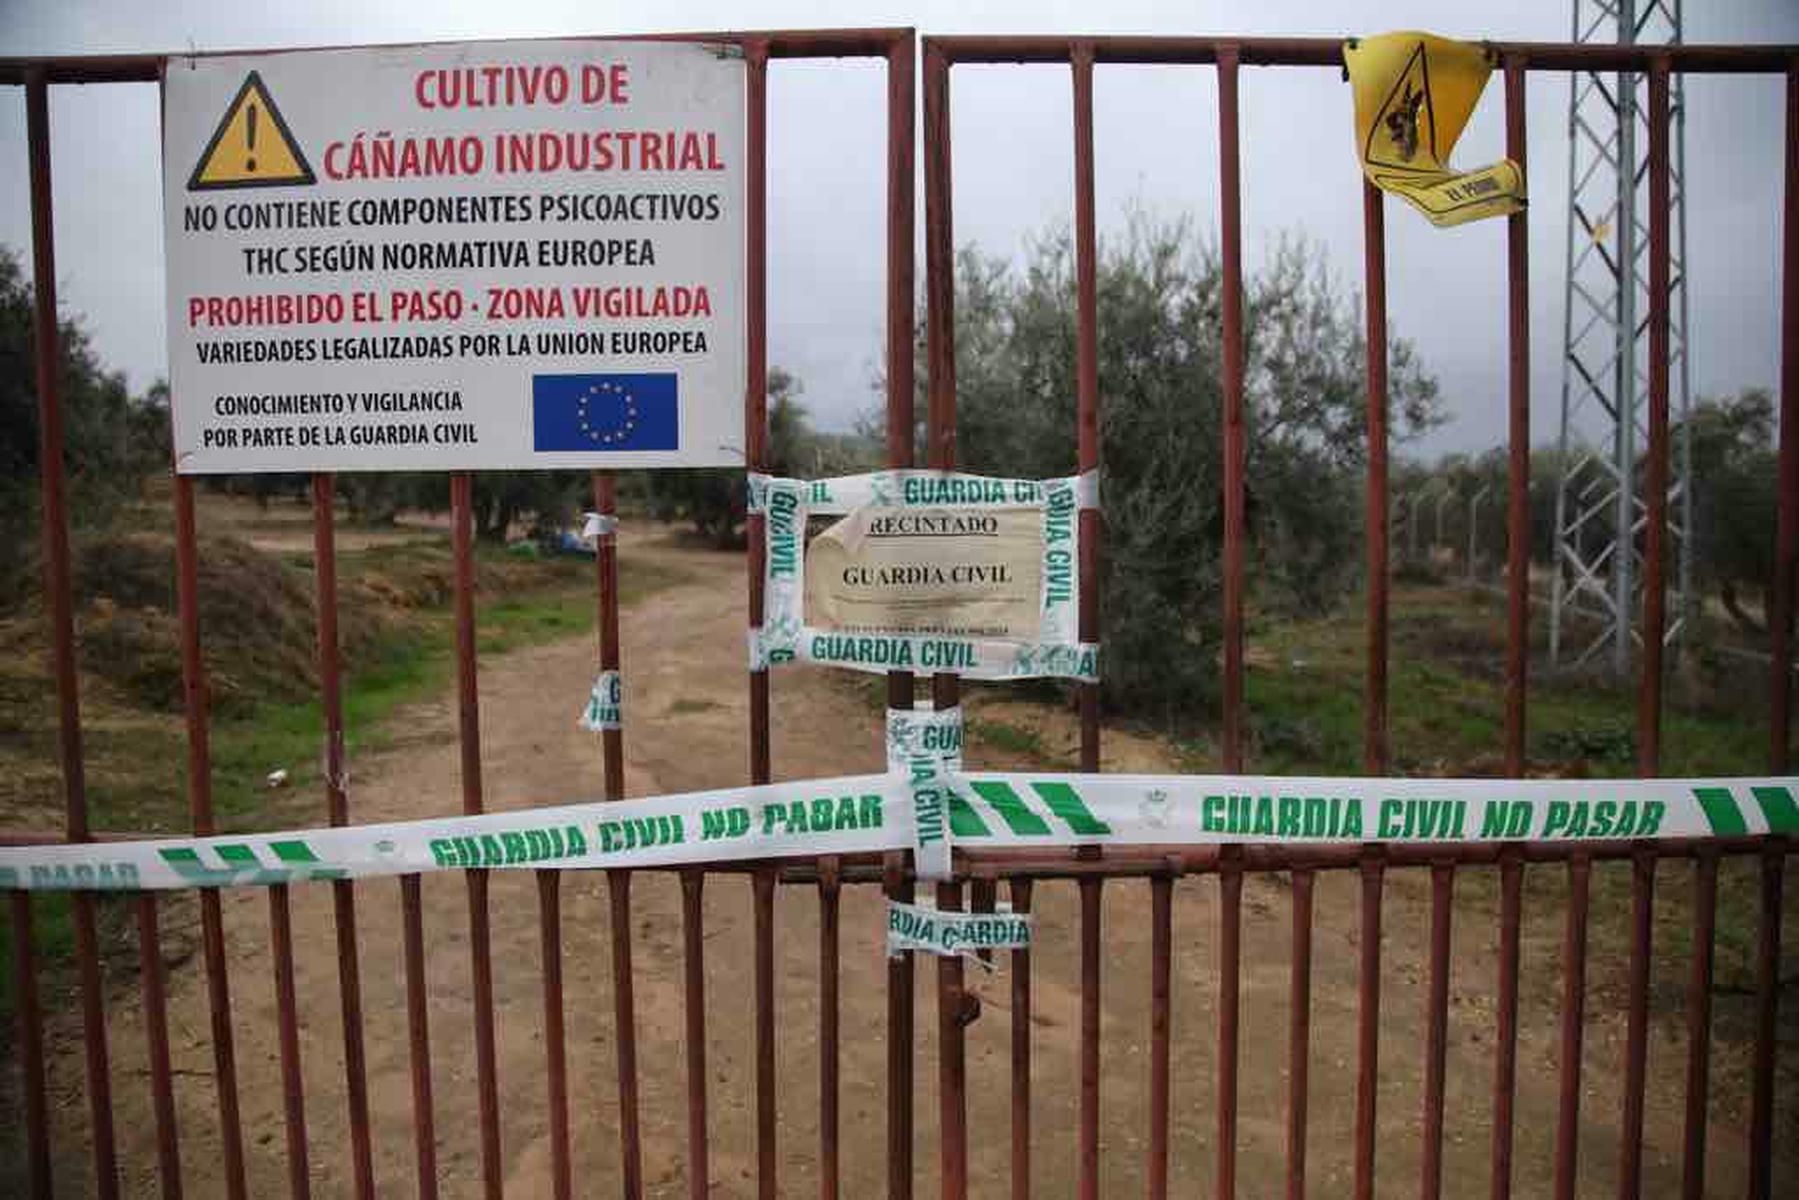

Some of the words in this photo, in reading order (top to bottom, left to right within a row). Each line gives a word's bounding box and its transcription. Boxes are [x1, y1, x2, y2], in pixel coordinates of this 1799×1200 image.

[416, 66, 568, 109] CULTIVO
[582, 65, 627, 104] DE
[324, 132, 483, 181] CÁÑAMO
[497, 132, 725, 173] INDUSTRIAL
[184, 205, 217, 232] NO
[224, 200, 340, 230] CONTIENE
[348, 196, 532, 225] COMPONENTES
[540, 194, 719, 221] PSICOACTIVOS
[242, 247, 288, 275] THC
[295, 240, 374, 273] SEGÚN
[383, 241, 530, 270] NORMATIVA
[538, 239, 654, 266] EUROPEA
[189, 293, 344, 328] PROHIBIDO
[353, 292, 383, 322] EL
[392, 290, 462, 322] PASO
[487, 288, 565, 319] ZONA
[573, 287, 711, 318] VIGILADA
[196, 339, 317, 364] VARIEDADES
[322, 335, 453, 360] LEGALIZADAS
[460, 335, 500, 357] POR
[507, 334, 531, 356] LA
[537, 333, 604, 355] UNION
[611, 332, 707, 354] EUROPEA
[215, 394, 343, 416] CONOCIMIENTO
[348, 394, 358, 413] Y
[363, 391, 462, 412] VIGILANCIA
[204, 428, 238, 448] POR
[242, 427, 294, 447] PARTE
[299, 426, 320, 446] DE
[325, 426, 346, 446] LA
[350, 424, 429, 445] GUARDIA
[434, 424, 478, 443] CIVIL
[905, 478, 1005, 503] GUARDIA
[843, 566, 944, 586] GUARDIA
[951, 564, 1013, 585] CIVIL
[1046, 550, 1071, 608] CIVIL
[812, 635, 914, 667] GUARDIA
[920, 640, 977, 669] CIVIL
[914, 787, 945, 849] CIVIL
[1202, 795, 1364, 839] GUARDIA
[1377, 798, 1466, 839] CIVIL
[1480, 800, 1534, 839] NO
[1541, 800, 1666, 838] PASAR
[430, 826, 588, 866] GUARDIA
[598, 814, 685, 853] CIVIL
